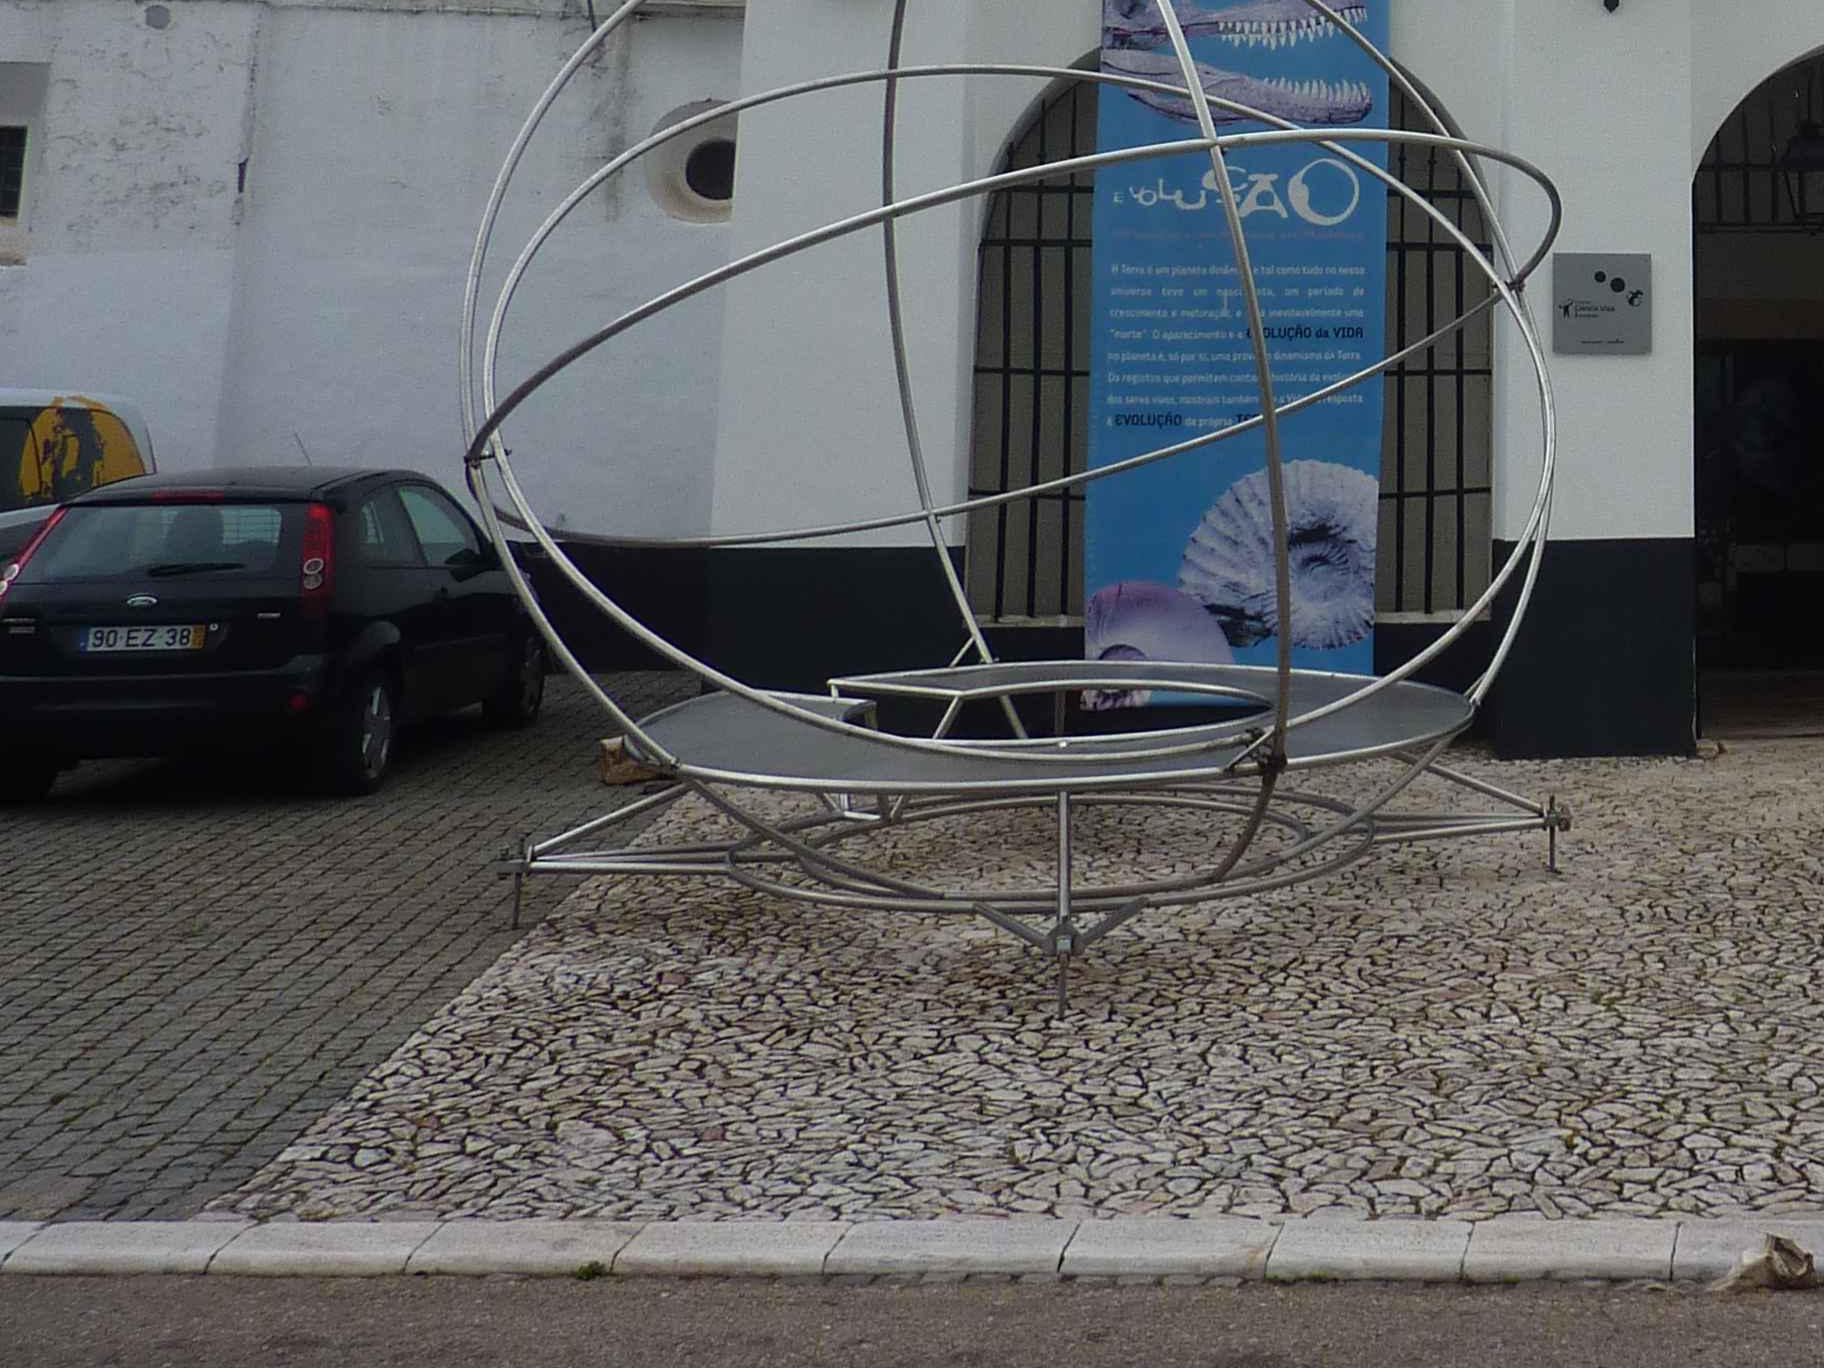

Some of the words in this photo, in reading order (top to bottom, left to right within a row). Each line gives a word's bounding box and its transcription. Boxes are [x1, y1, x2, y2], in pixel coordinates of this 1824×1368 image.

[1246, 324, 1312, 341] EOLUÇÃO
[1315, 328, 1329, 339] da
[1334, 327, 1364, 338] VIDA
[1115, 412, 1182, 428] EVOLUÇÃO
